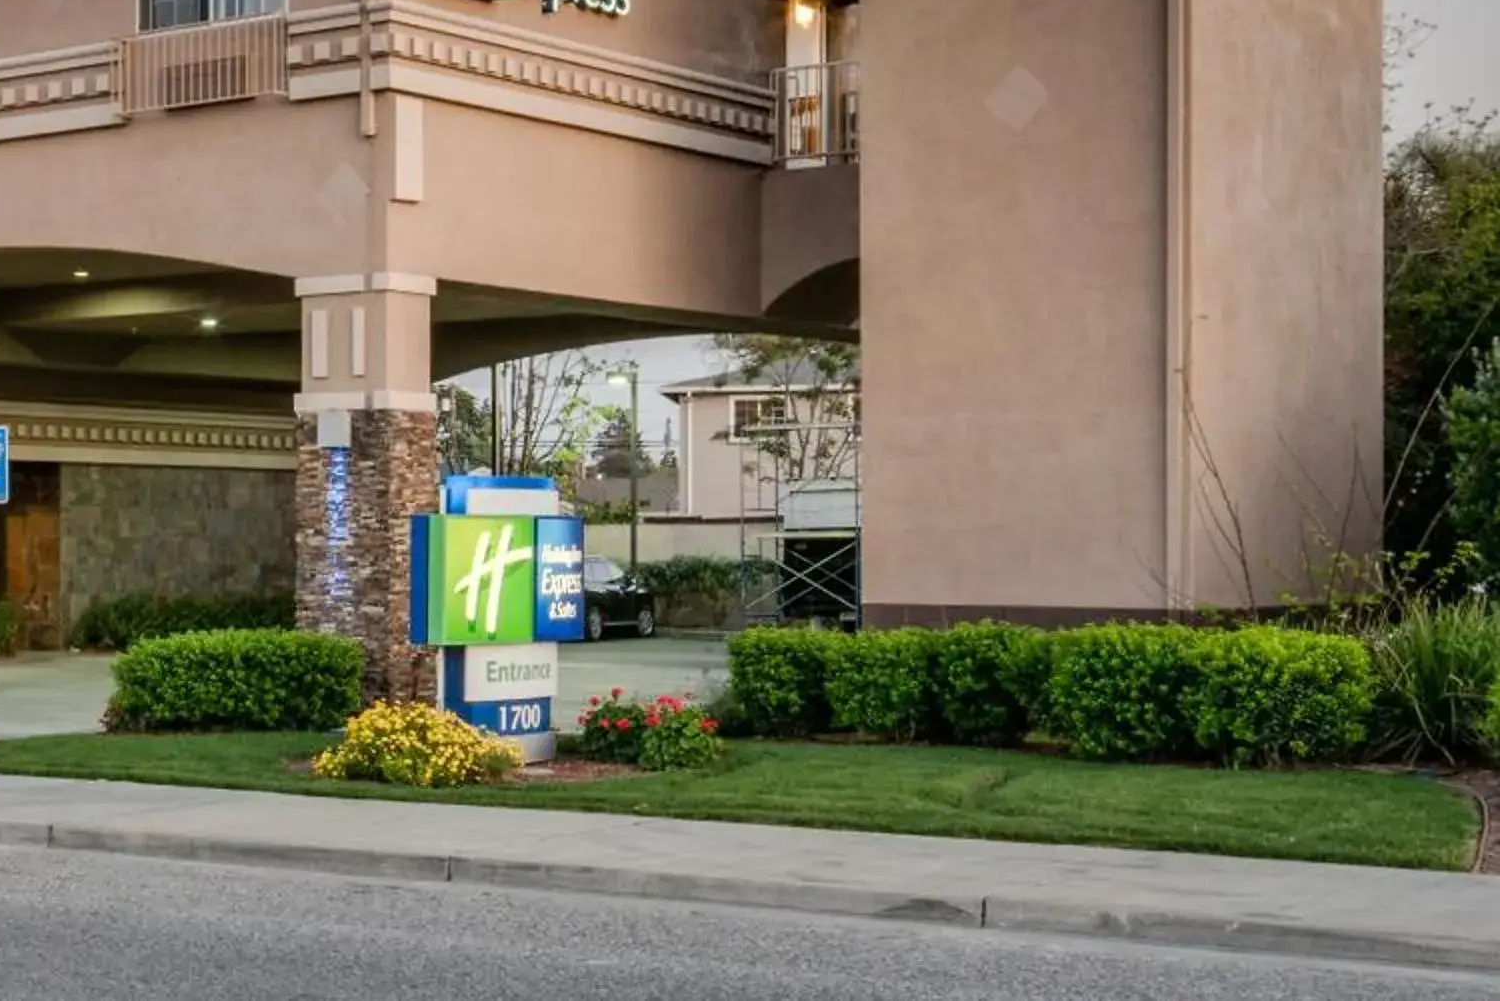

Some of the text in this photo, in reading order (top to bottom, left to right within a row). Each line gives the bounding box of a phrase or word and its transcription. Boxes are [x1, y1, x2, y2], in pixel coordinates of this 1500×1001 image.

[541, 568, 582, 600] Express
[486, 661, 552, 682] Entrance
[499, 704, 541, 731] 1700
